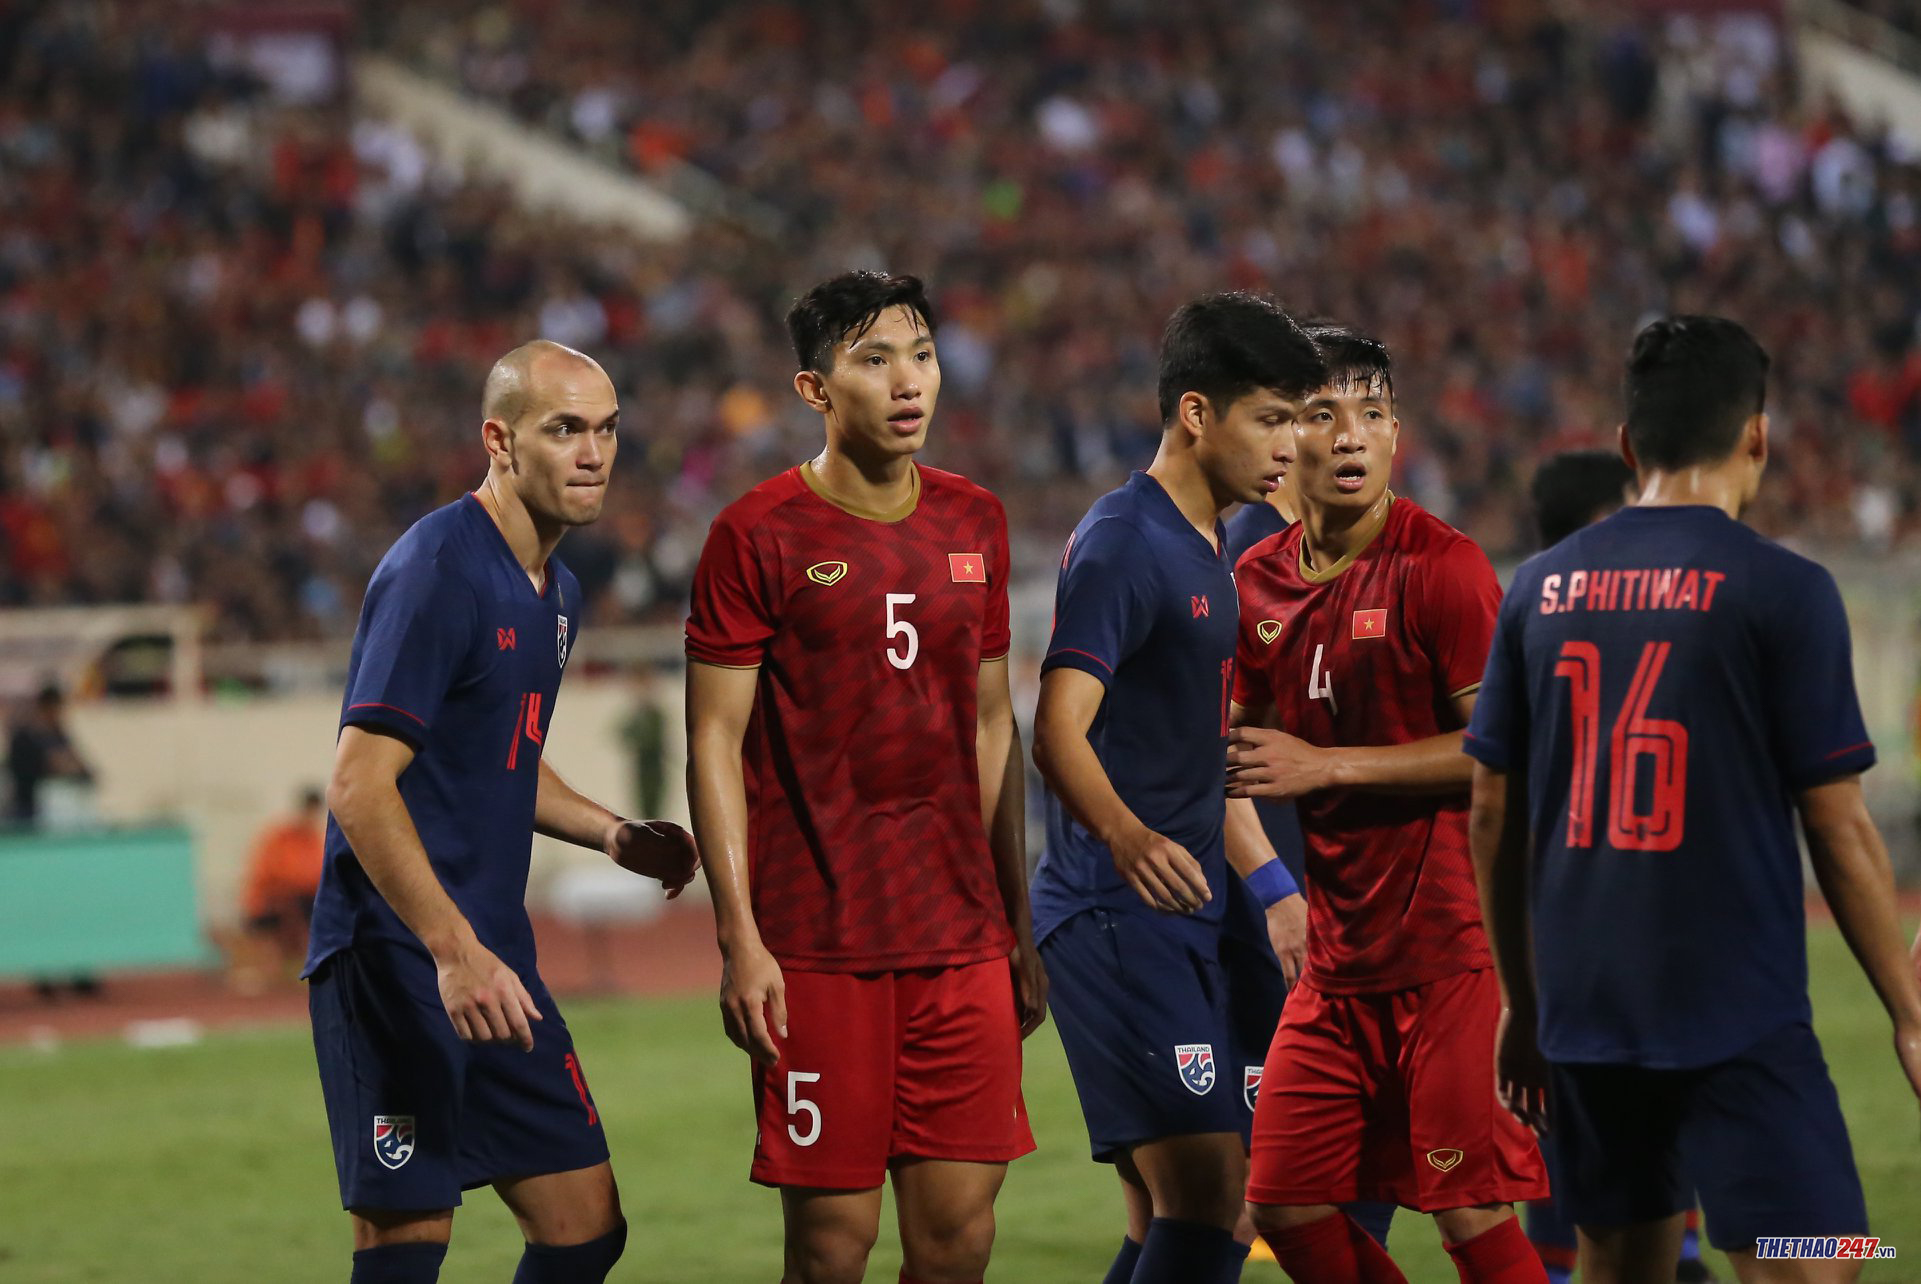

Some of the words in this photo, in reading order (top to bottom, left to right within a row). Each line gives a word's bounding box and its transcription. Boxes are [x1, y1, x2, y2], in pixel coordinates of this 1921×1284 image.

[1540, 568, 1726, 615] S.PHITIWAT
[886, 593, 919, 670] 5
[1308, 643, 1338, 716] 4
[506, 692, 543, 770] 14
[1554, 640, 1689, 851] 16
[787, 1070, 822, 1147] 5
